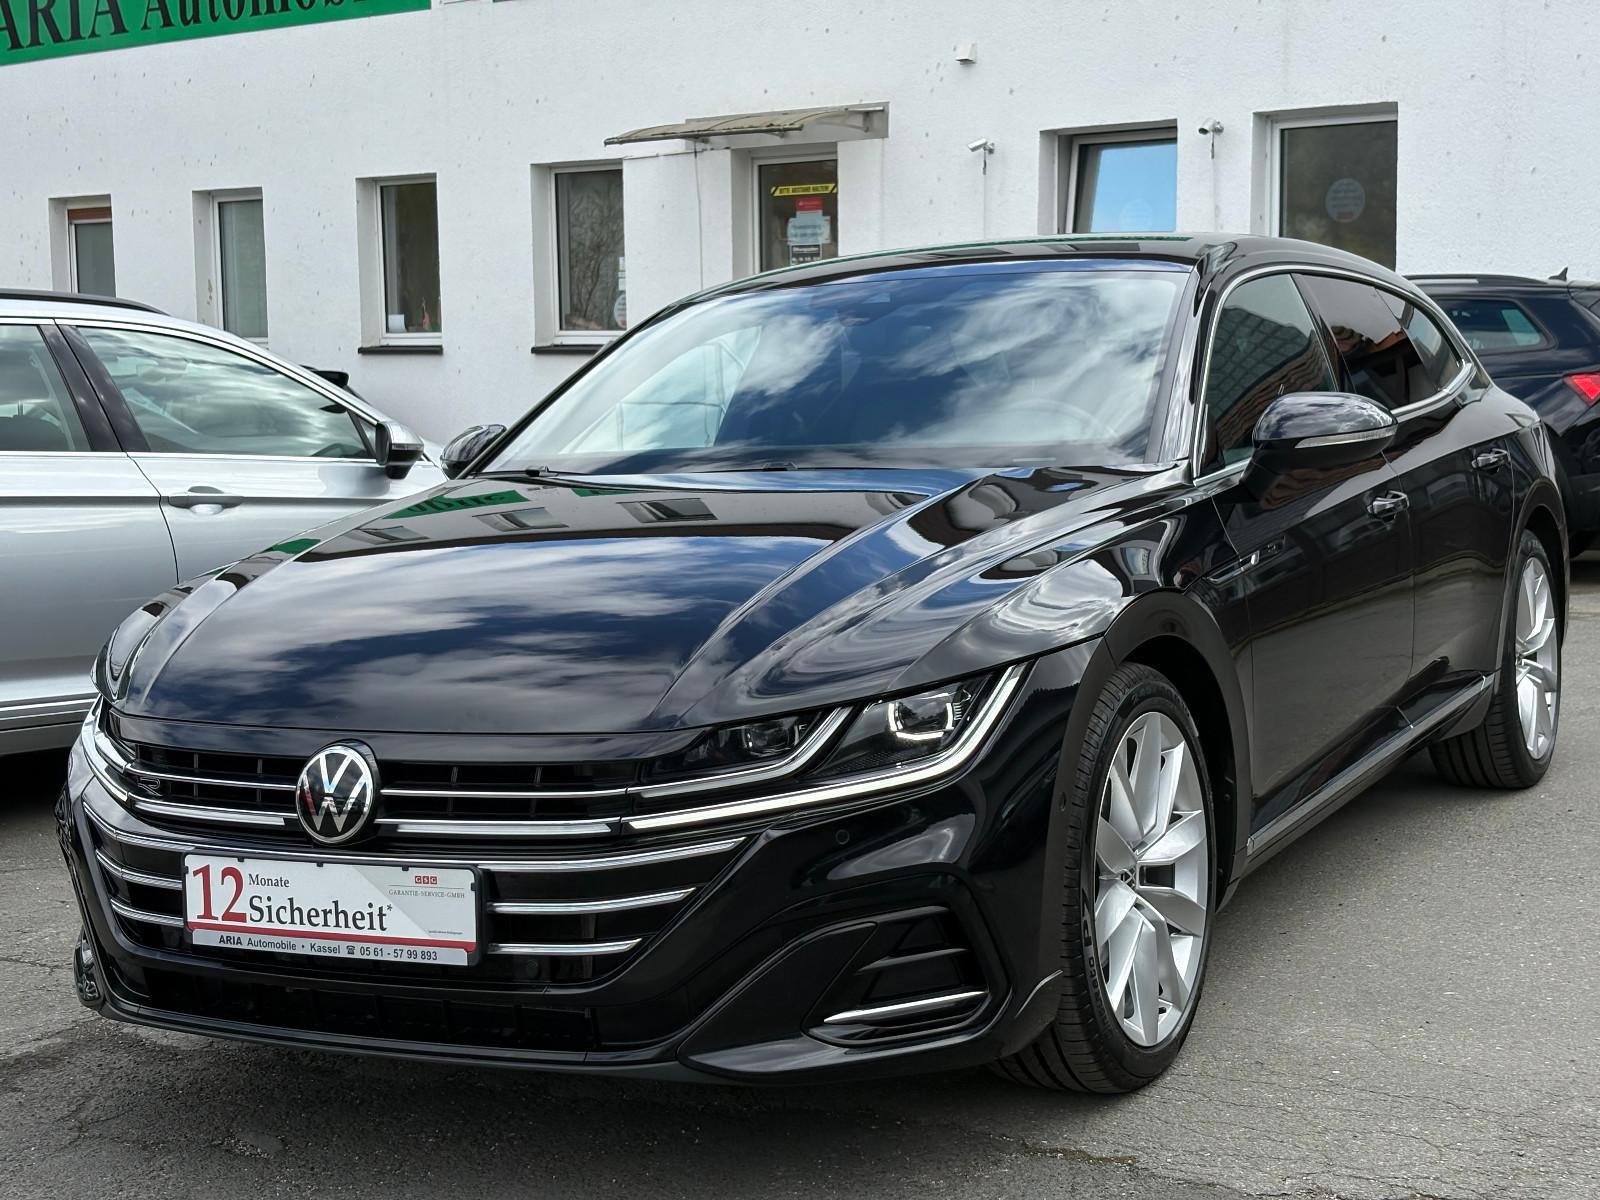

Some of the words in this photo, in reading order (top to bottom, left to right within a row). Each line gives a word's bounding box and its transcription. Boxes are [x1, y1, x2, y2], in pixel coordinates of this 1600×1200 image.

[249, 873, 290, 888] Monate
[193, 864, 247, 923] 12
[219, 935, 243, 946] ARIA
[247, 938, 297, 950] Automobile
[310, 942, 341, 954] Kassel
[360, 947, 371, 956] 05
[373, 948, 384, 957] 61
[393, 949, 404, 958] 57
[406, 950, 418, 959] 99
[420, 950, 438, 960] 893
